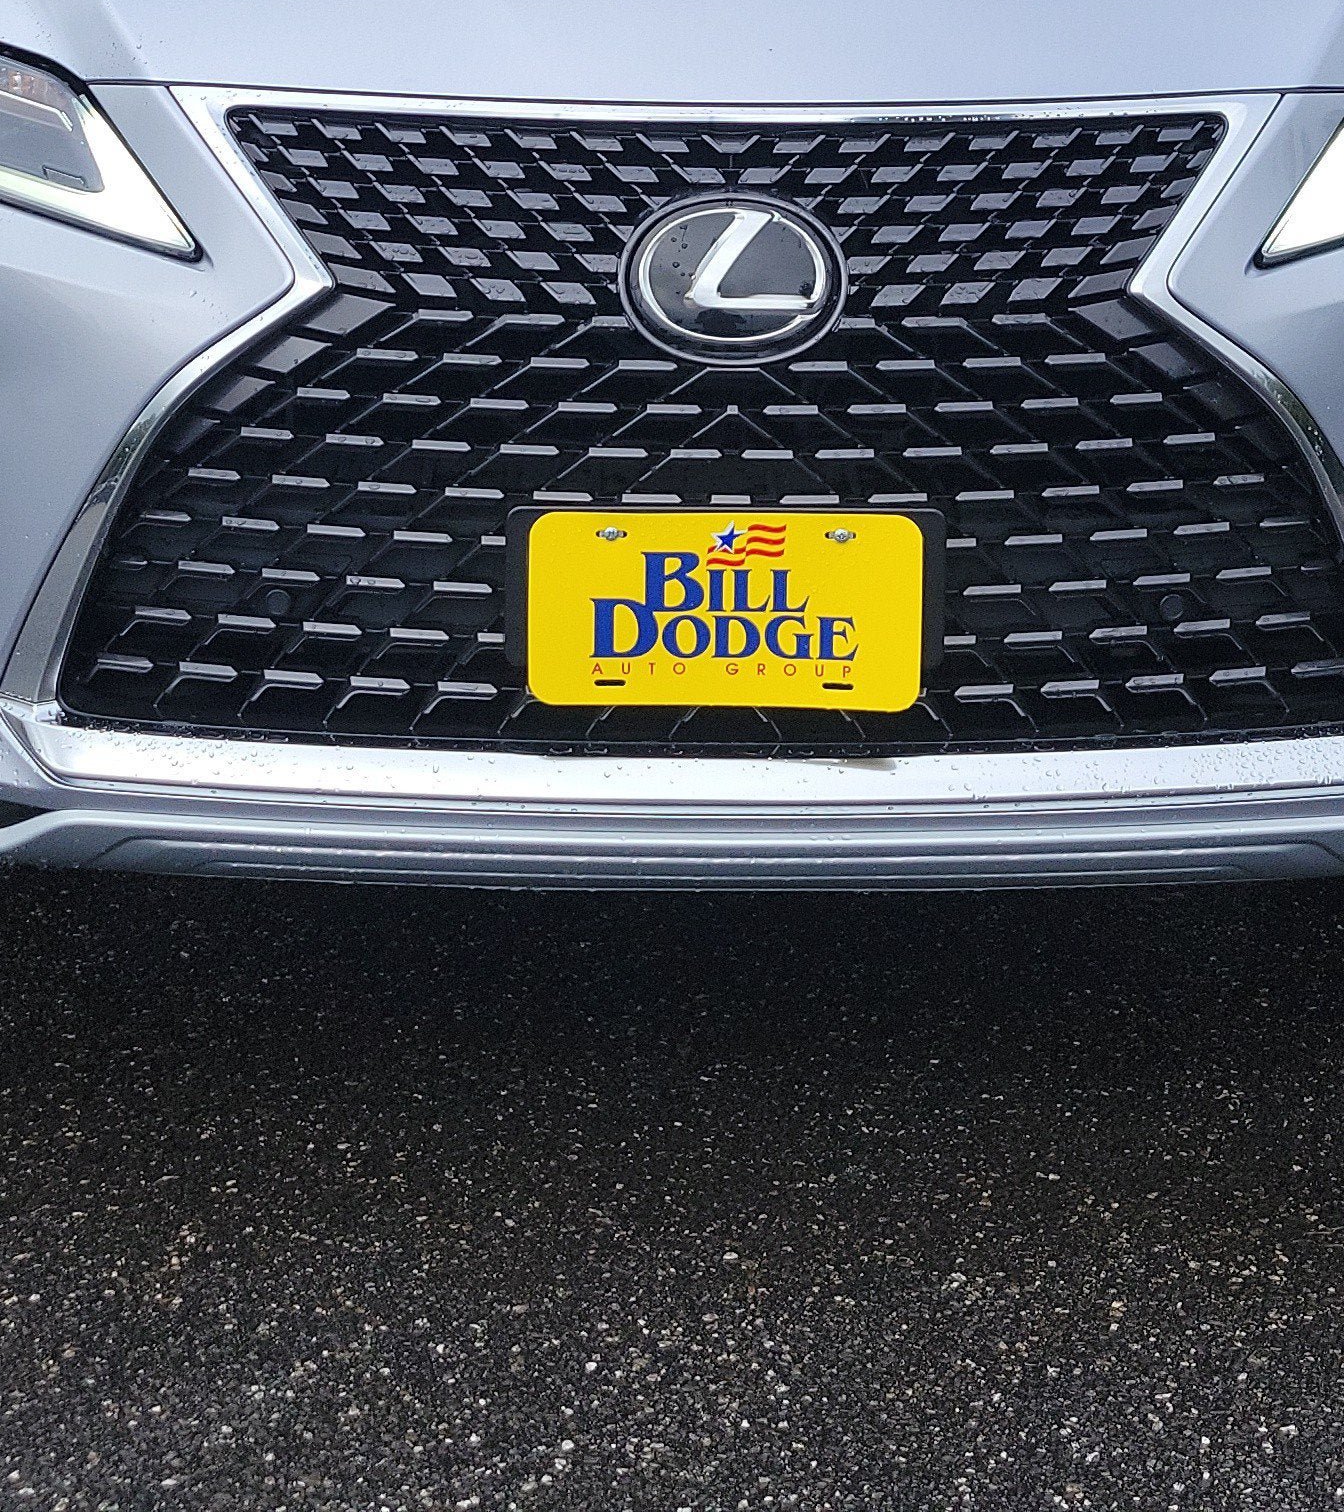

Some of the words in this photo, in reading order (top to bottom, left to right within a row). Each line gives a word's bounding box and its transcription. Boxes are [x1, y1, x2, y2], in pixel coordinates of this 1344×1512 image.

[640, 551, 810, 613] BILL
[589, 598, 859, 661] DODGE
[591, 662, 686, 676] AUTO
[725, 663, 853, 678] GROUP
